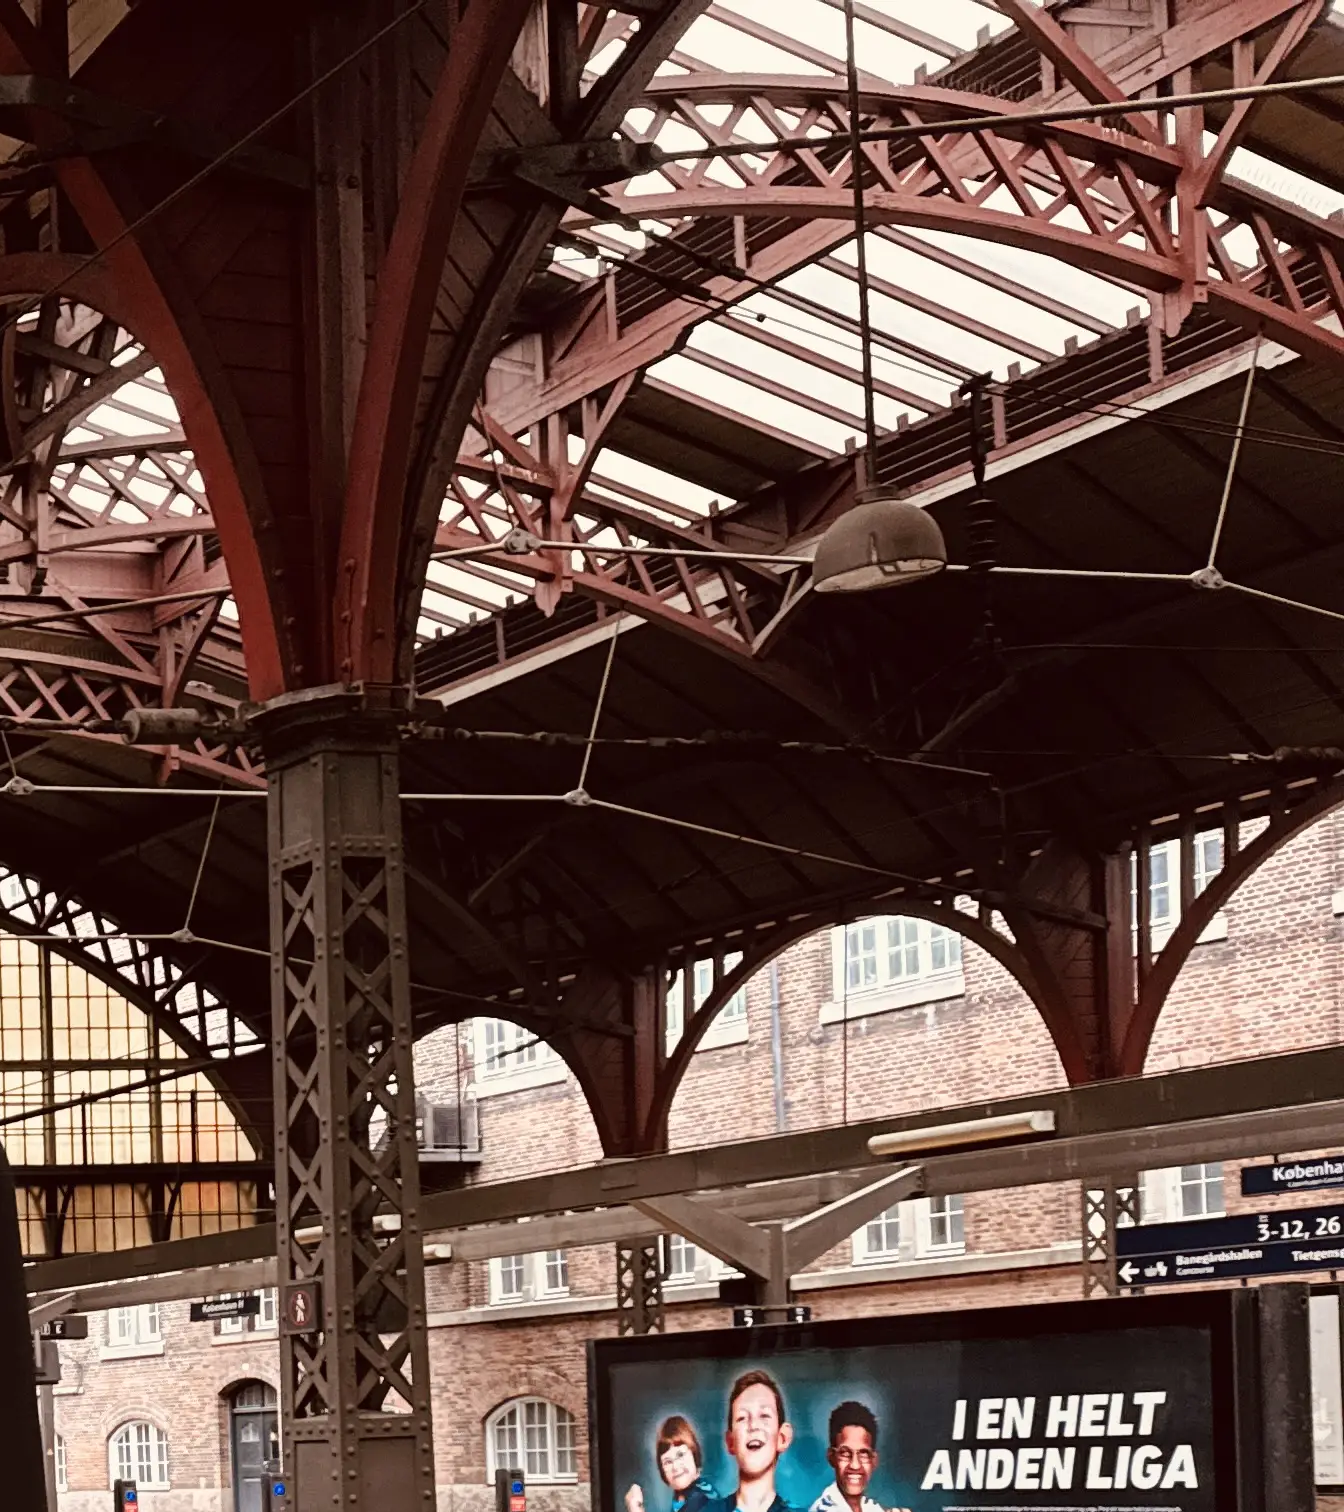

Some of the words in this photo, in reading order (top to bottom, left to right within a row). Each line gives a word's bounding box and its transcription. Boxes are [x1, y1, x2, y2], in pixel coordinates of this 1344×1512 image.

[1273, 1161, 1344, 1181] Københa
[1257, 1222, 1310, 1241] 3-12,
[1315, 1216, 1341, 1236] 26
[952, 1400, 967, 1440] I
[976, 1396, 1036, 1439] EN
[1045, 1391, 1167, 1438] HELT
[920, 1447, 1076, 1490] ANDEN
[1085, 1444, 1199, 1490] LIGA
